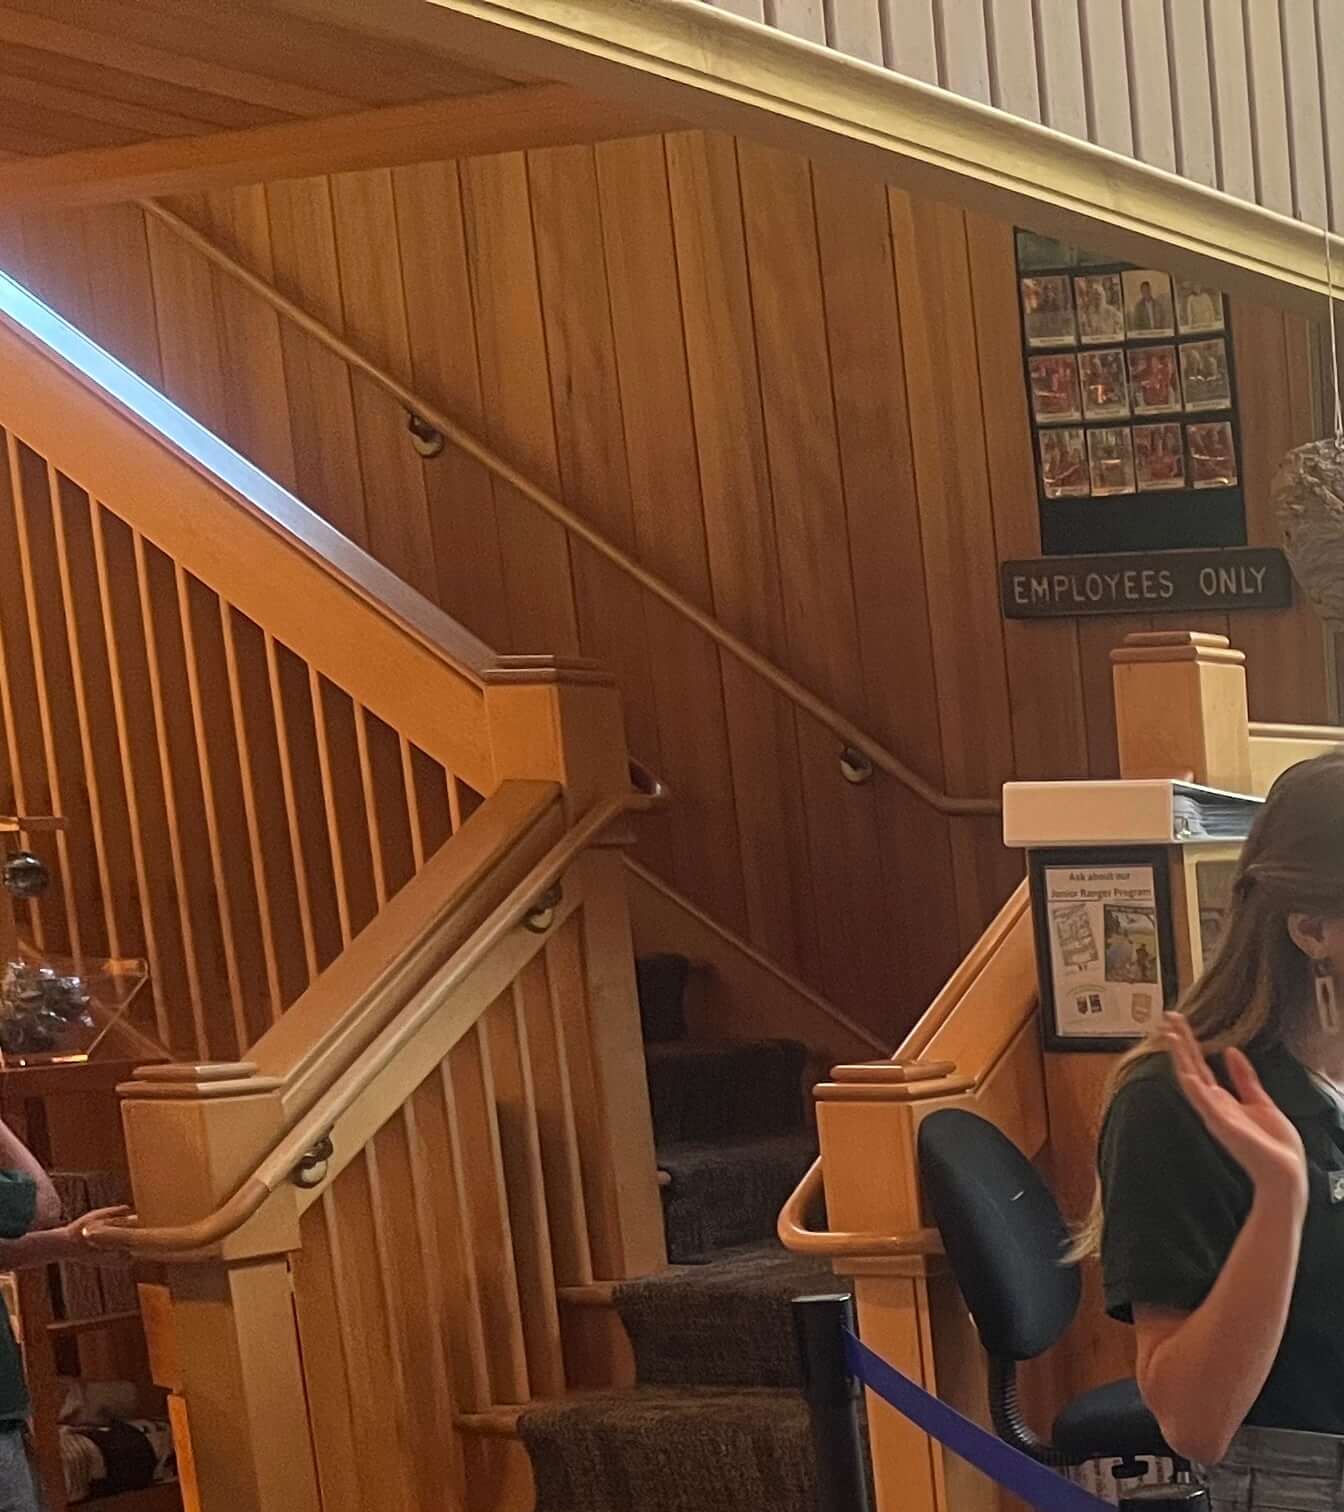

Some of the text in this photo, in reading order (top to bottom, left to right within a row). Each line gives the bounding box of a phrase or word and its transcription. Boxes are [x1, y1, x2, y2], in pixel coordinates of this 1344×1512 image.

[1012, 565, 1269, 604] EMPLOYEES ONLY
[1080, 888, 1111, 900] Ranger
[1112, 887, 1152, 899] Program
